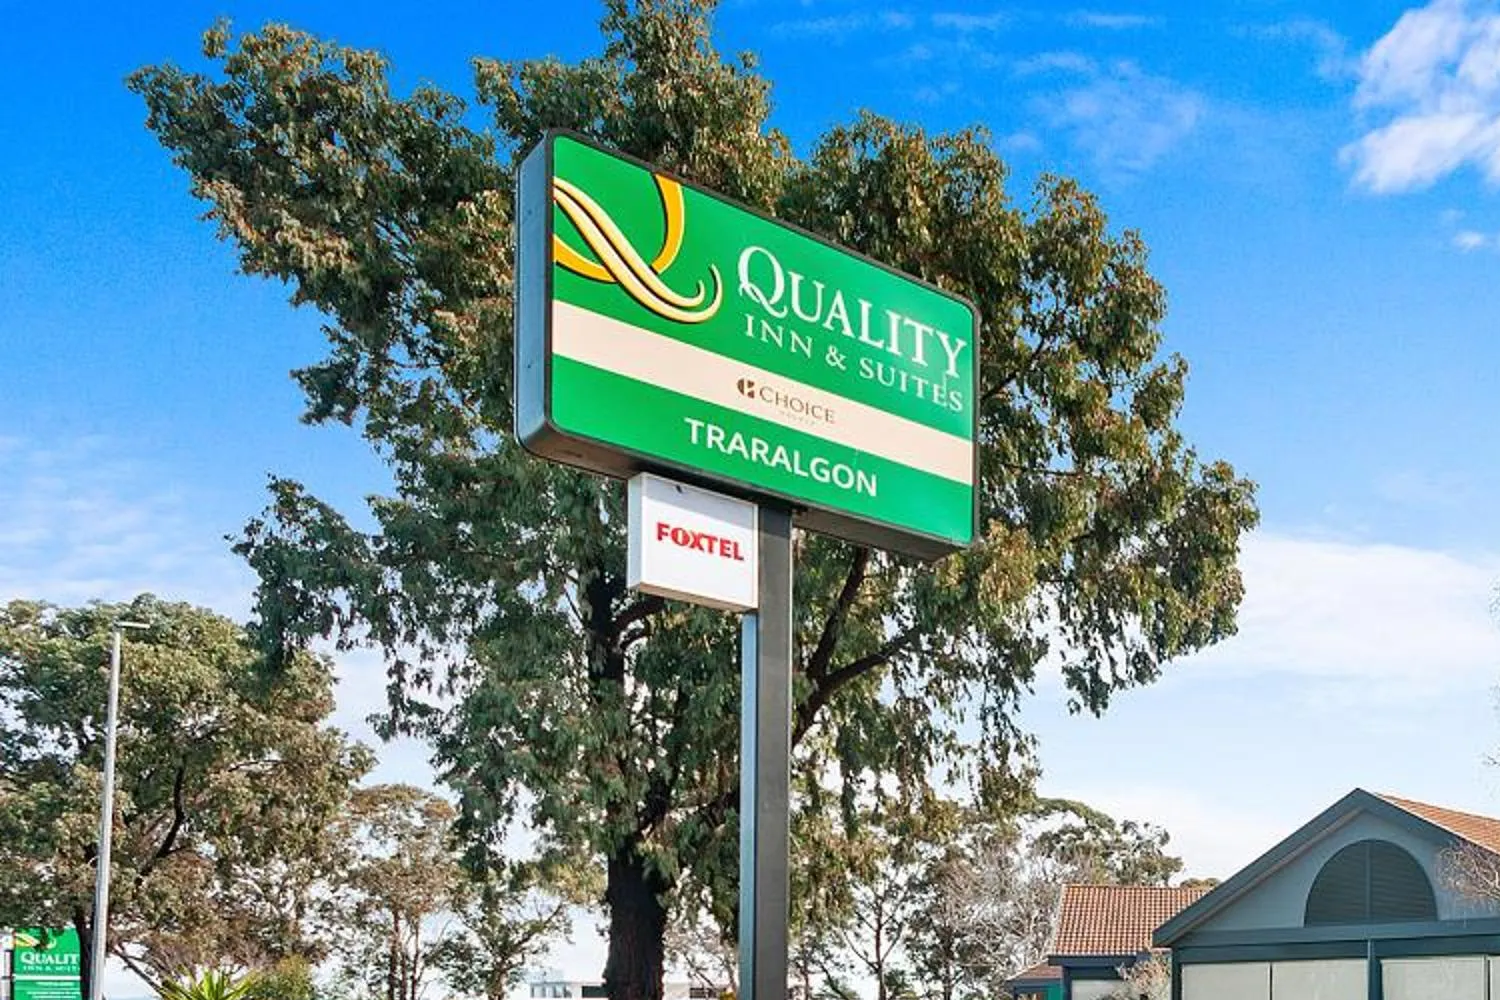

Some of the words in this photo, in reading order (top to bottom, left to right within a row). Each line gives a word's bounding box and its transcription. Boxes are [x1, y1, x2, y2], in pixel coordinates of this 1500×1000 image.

[738, 246, 966, 378] QUALITY
[745, 314, 813, 358] INN
[826, 347, 847, 370] &
[859, 358, 963, 413] SUITES
[759, 386, 836, 423] CHOICE
[685, 418, 877, 497] TRARALGON
[656, 522, 744, 560] FOXTEL
[20, 951, 80, 965] QUALIT
